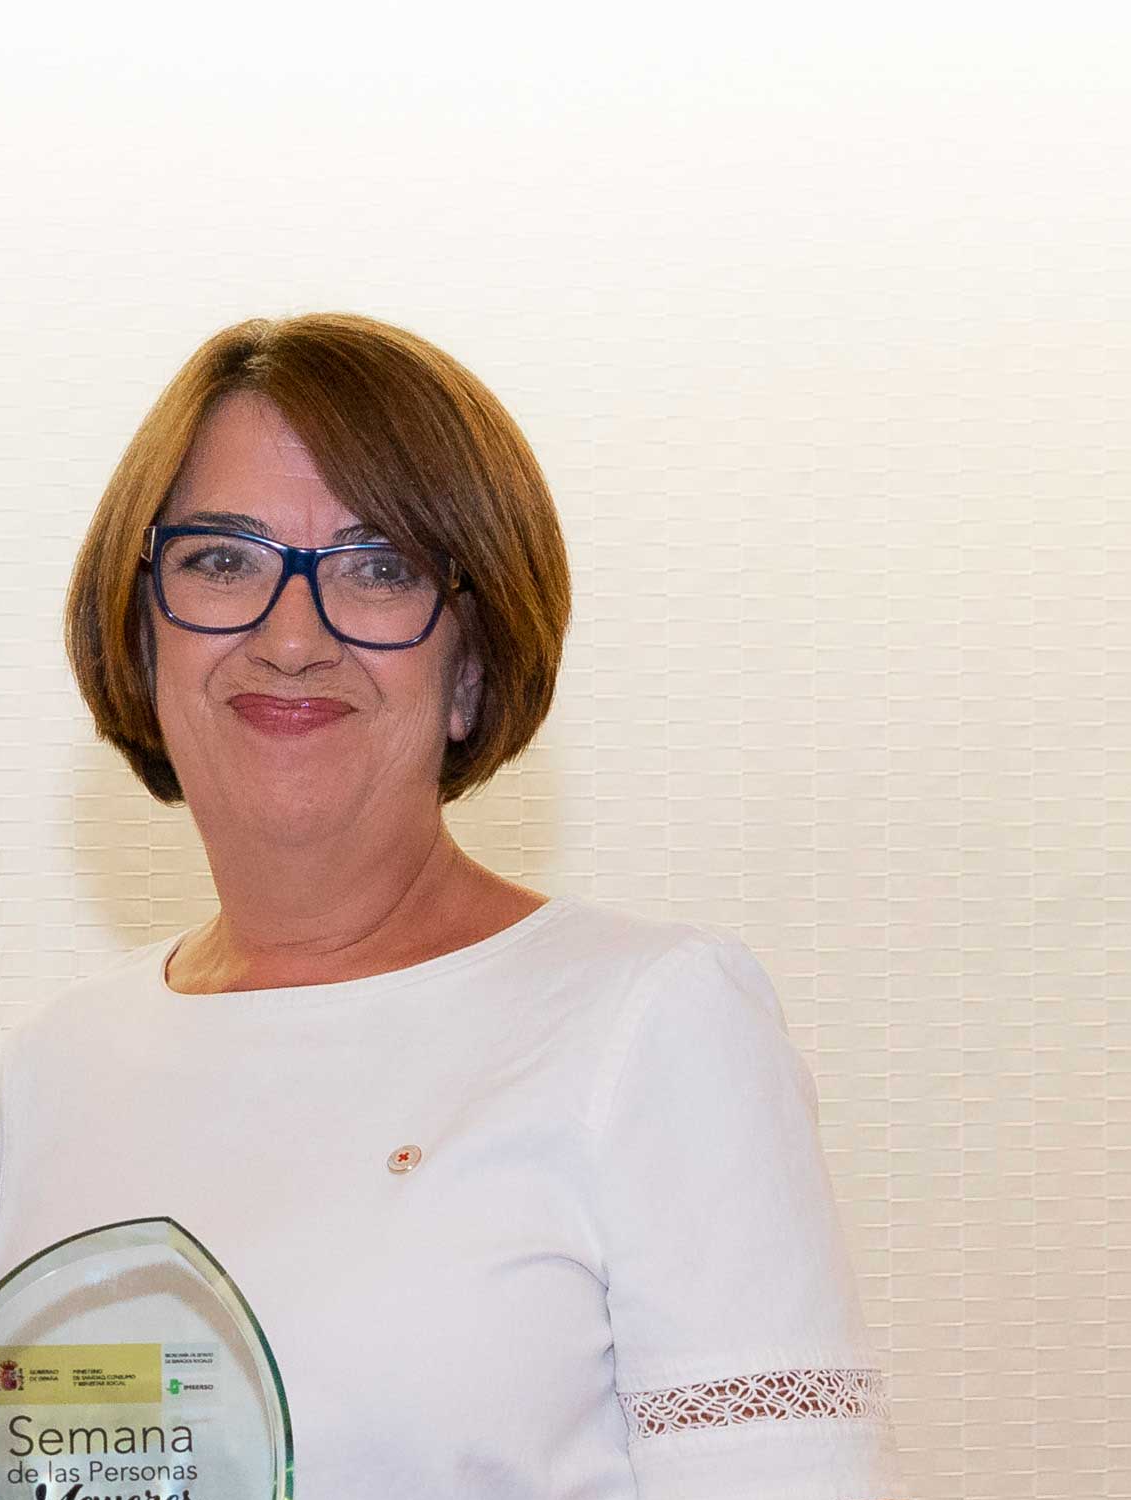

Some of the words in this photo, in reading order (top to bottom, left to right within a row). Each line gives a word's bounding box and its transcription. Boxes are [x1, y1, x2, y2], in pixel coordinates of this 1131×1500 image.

[8, 1415, 193, 1457] Semana
[7, 1460, 39, 1484] de
[48, 1460, 80, 1483] las
[89, 1460, 198, 1482] Personas
